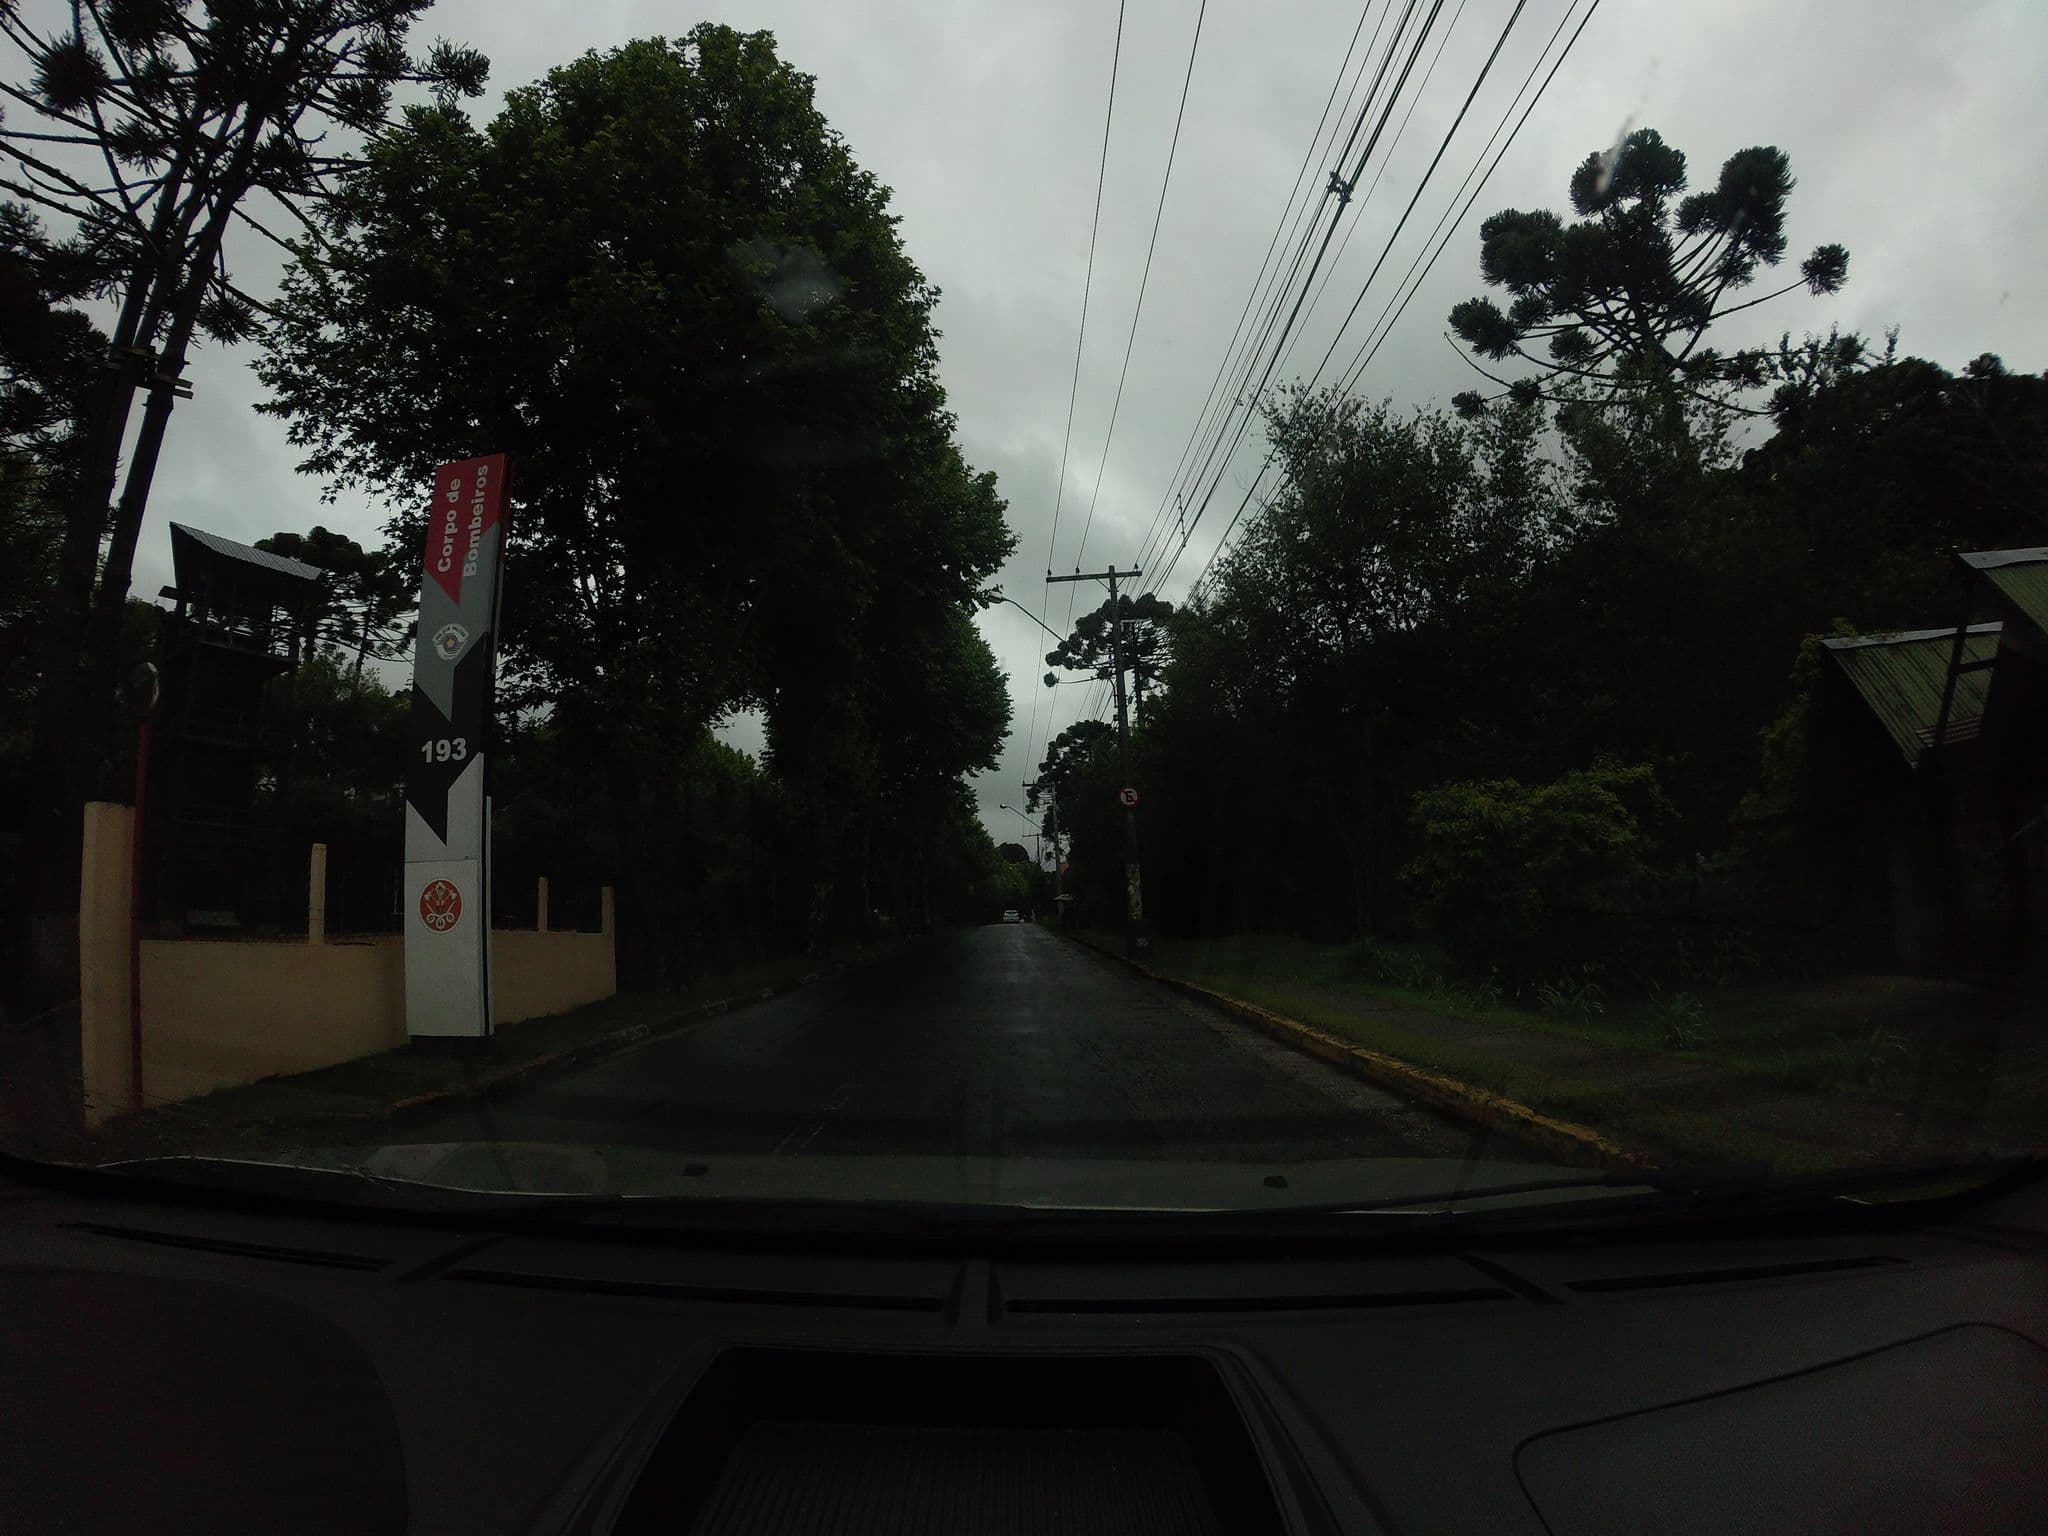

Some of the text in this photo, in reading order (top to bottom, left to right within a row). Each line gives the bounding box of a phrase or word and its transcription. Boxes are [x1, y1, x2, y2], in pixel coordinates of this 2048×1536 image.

[437, 478, 461, 573] Corpo de
[463, 464, 489, 577] Bombeiros
[421, 737, 467, 763] 193
